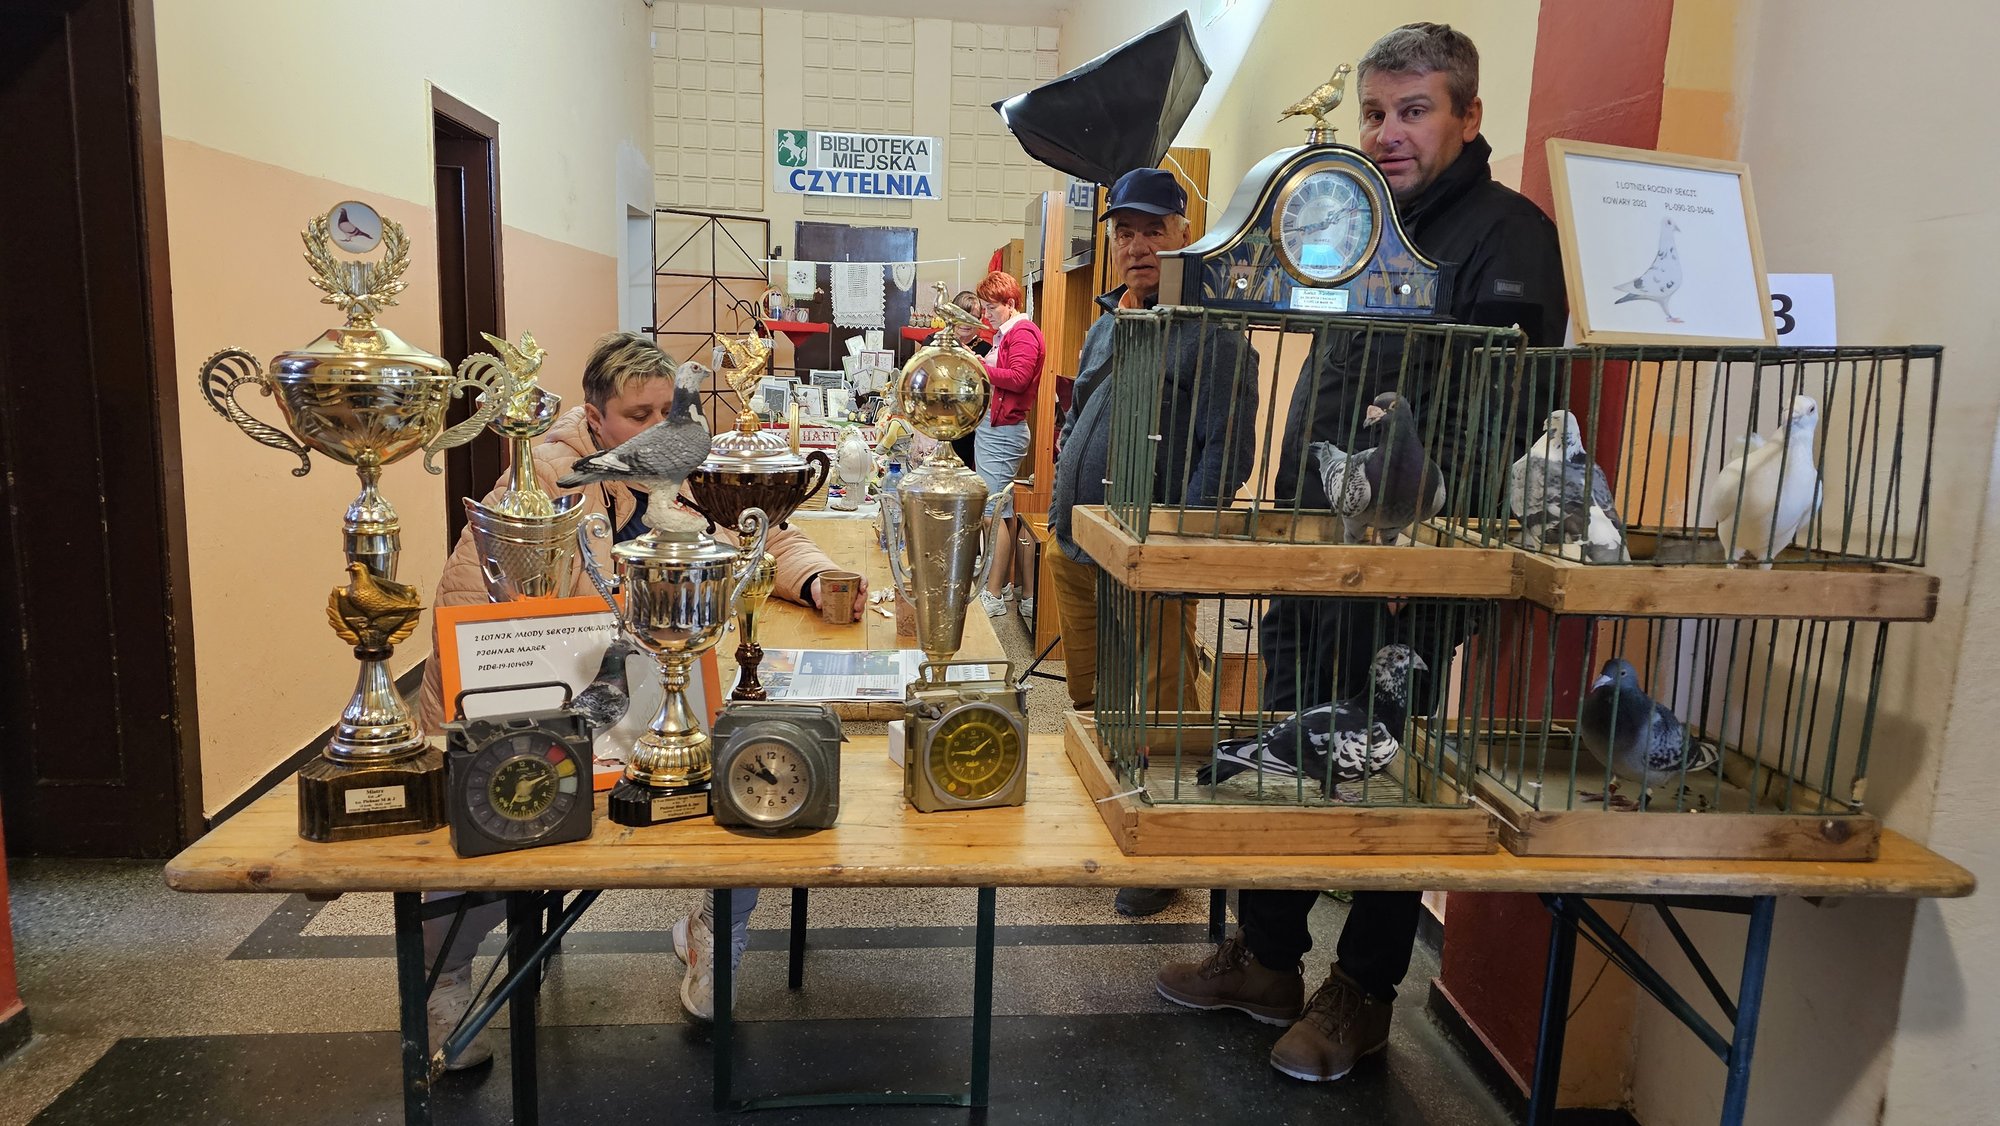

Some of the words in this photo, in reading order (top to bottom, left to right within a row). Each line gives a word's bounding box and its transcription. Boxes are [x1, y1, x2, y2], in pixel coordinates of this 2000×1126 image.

[820, 135, 928, 155] BIBLIOTEKA
[833, 152, 916, 171] MIEJSKA
[789, 169, 932, 197] CZYTELNIA
[1602, 196, 1631, 206] KOWARY
[781, 796, 787, 804] 5
